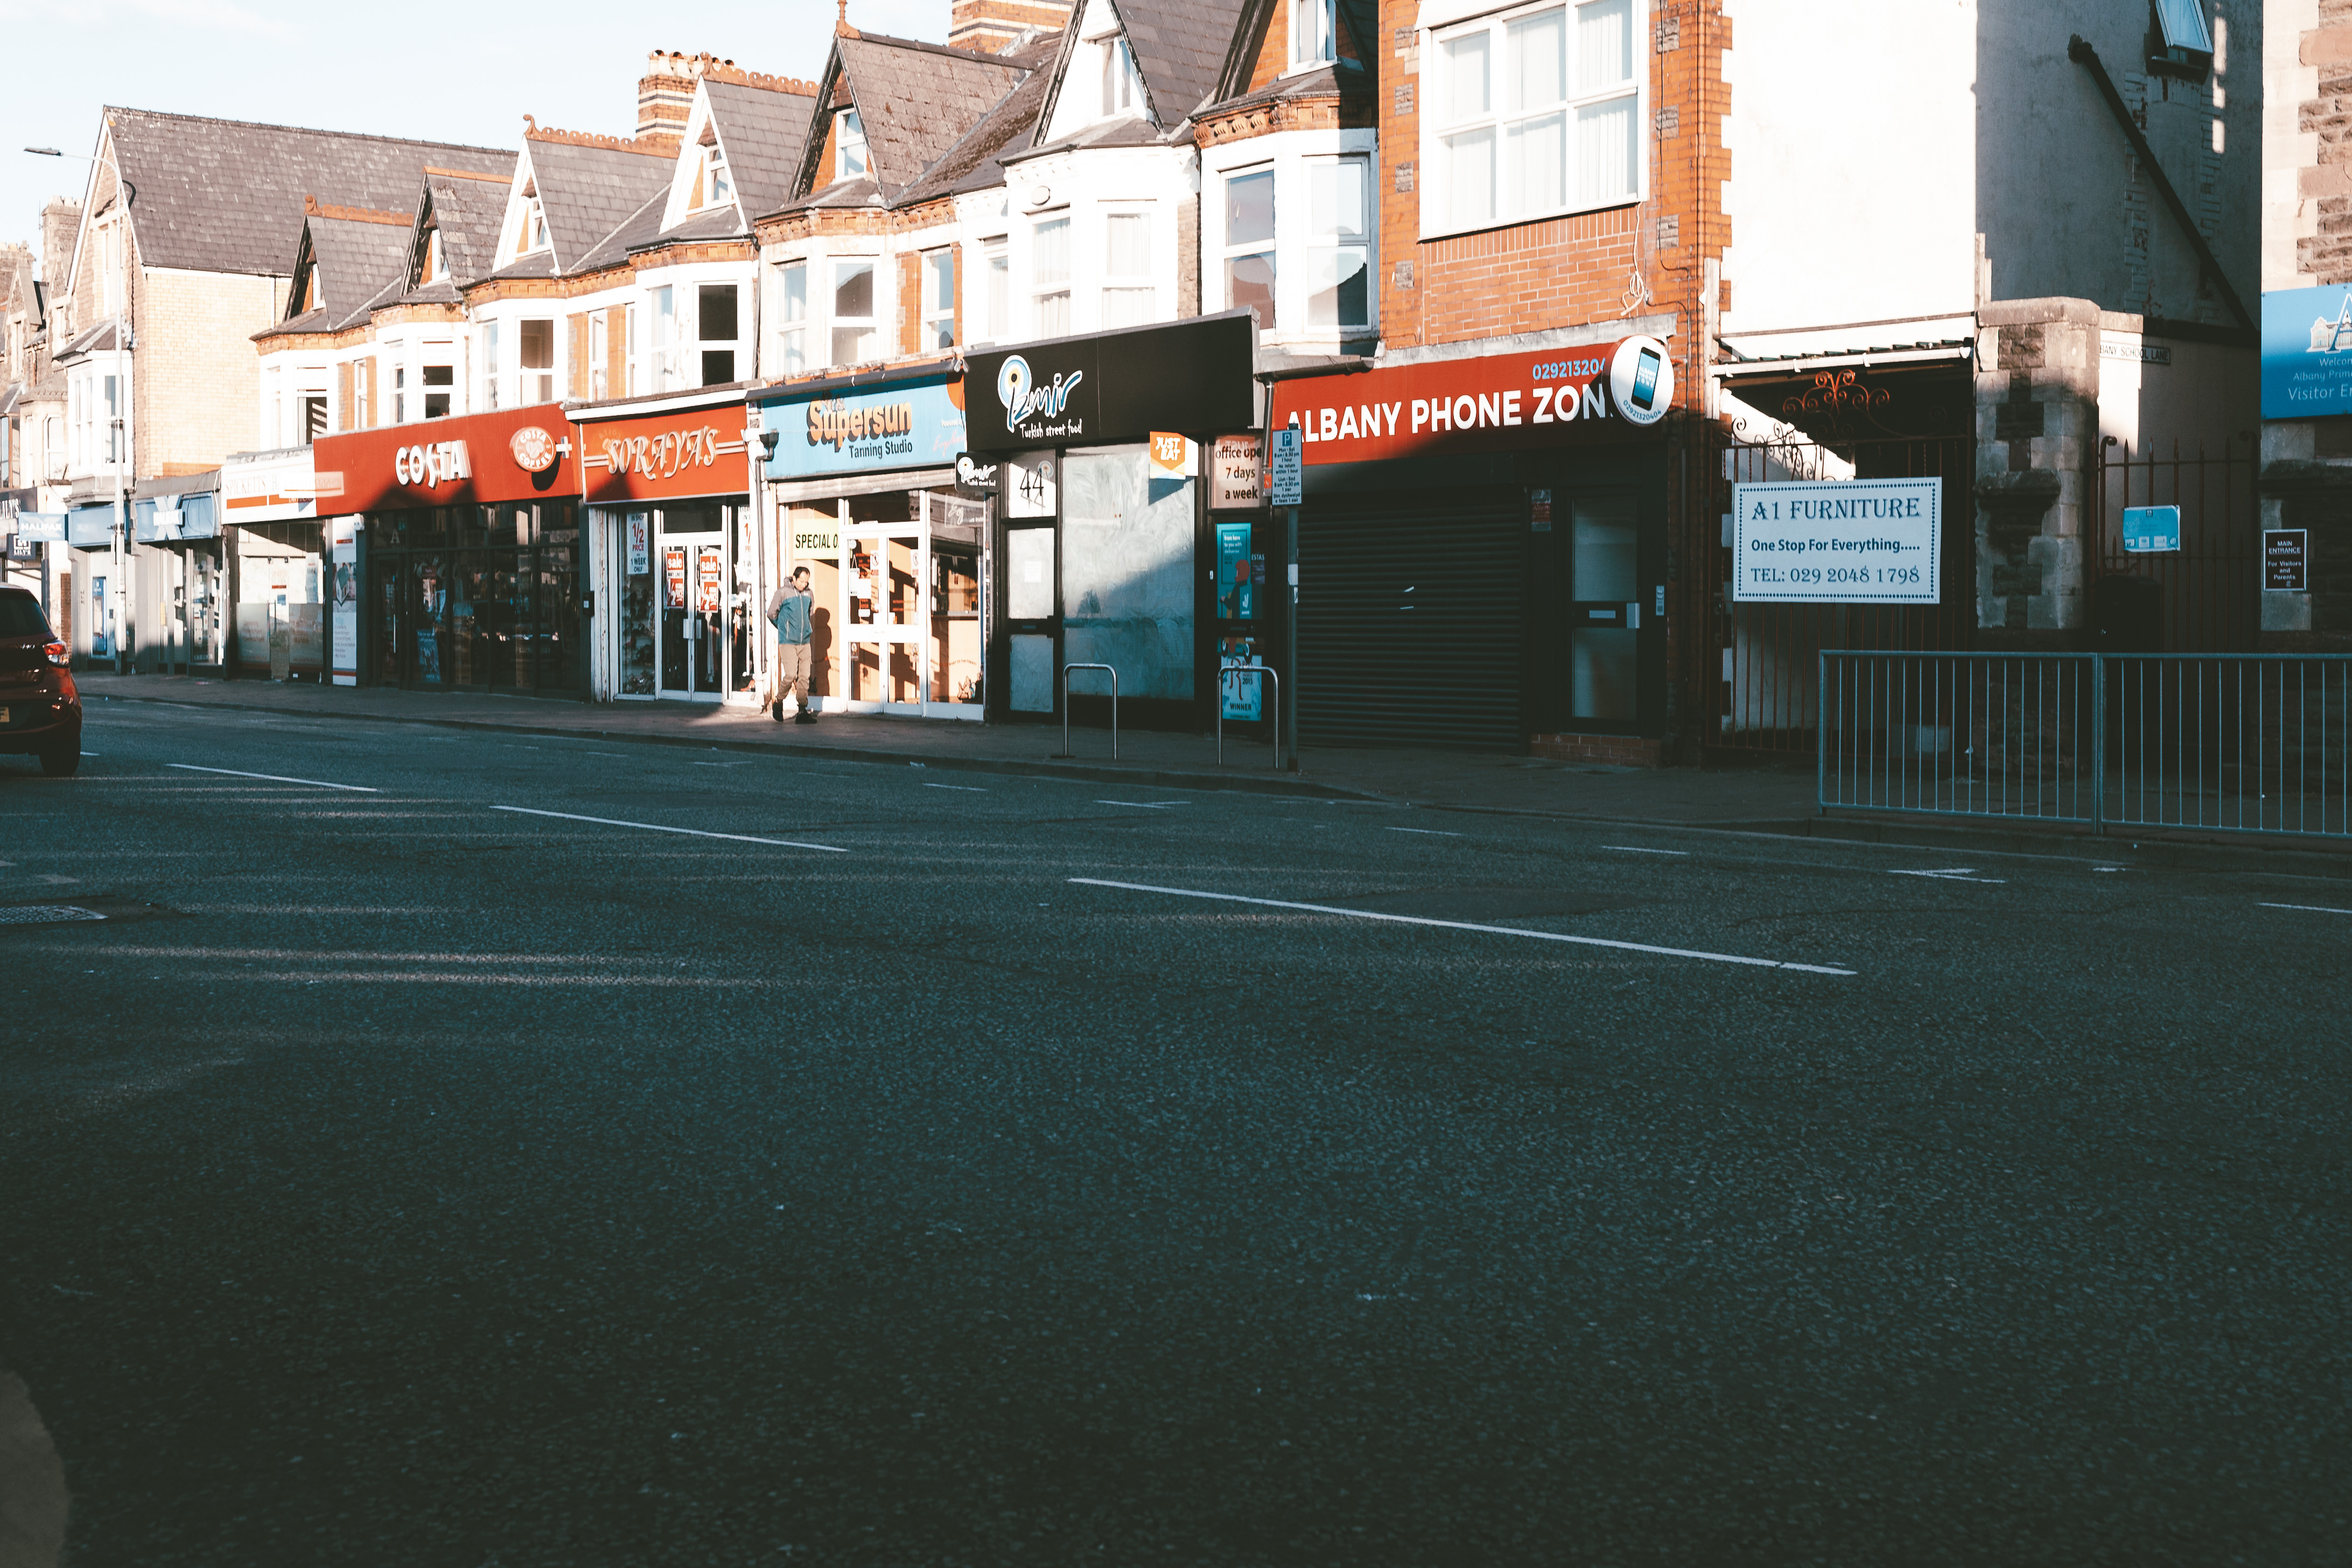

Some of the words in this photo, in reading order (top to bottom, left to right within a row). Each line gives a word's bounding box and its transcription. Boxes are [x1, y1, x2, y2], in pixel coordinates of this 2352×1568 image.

[2100, 345, 2117, 355] BANY
[2121, 346, 2149, 360] SCHOOL
[2151, 349, 2169, 361] LANE
[2293, 371, 2325, 382] Albany
[2288, 387, 2335, 401] Visitor
[1411, 390, 1522, 434] PHONE
[1532, 383, 1610, 424] ZON
[1623, 400, 1662, 421] 02921320404
[807, 398, 913, 453] Supersun
[1019, 422, 1044, 439] Turkish
[1046, 423, 1066, 437] street
[1067, 418, 1082, 437] food
[520, 430, 547, 444] COSTA
[1155, 437, 1181, 450] JUST
[608, 425, 720, 480] SORAYA'S
[849, 443, 883, 459] Tanning
[885, 438, 913, 454] Studio
[1160, 448, 1181, 460] EAT
[1215, 446, 1241, 459] office
[1244, 447, 1262, 461] ope
[396, 439, 472, 489] COSTA
[519, 451, 552, 467] COFFEE
[1226, 467, 1231, 479] 7
[1234, 466, 1256, 481] days
[225, 475, 266, 496] SPICKETTS
[1020, 468, 1044, 498] 44
[1225, 490, 1230, 499] a
[1233, 486, 1258, 499] week
[1751, 501, 1780, 520] A1
[1790, 498, 1922, 520] FURNITURE
[20, 522, 63, 531] HALIFAX
[632, 522, 645, 544] 1/2
[632, 544, 645, 552] PRICE
[795, 534, 830, 549] SPECIAL
[1751, 539, 1775, 551] One
[1778, 539, 1805, 554] Stop
[1809, 539, 1829, 551] For
[634, 557, 646, 565] WEEK
[668, 554, 683, 569] sale
[701, 556, 717, 572] sale
[1751, 568, 1785, 583] TEL:
[1790, 568, 1821, 585] 029
[1828, 565, 1870, 583] 2048
[1229, 702, 1252, 711] WINNER
